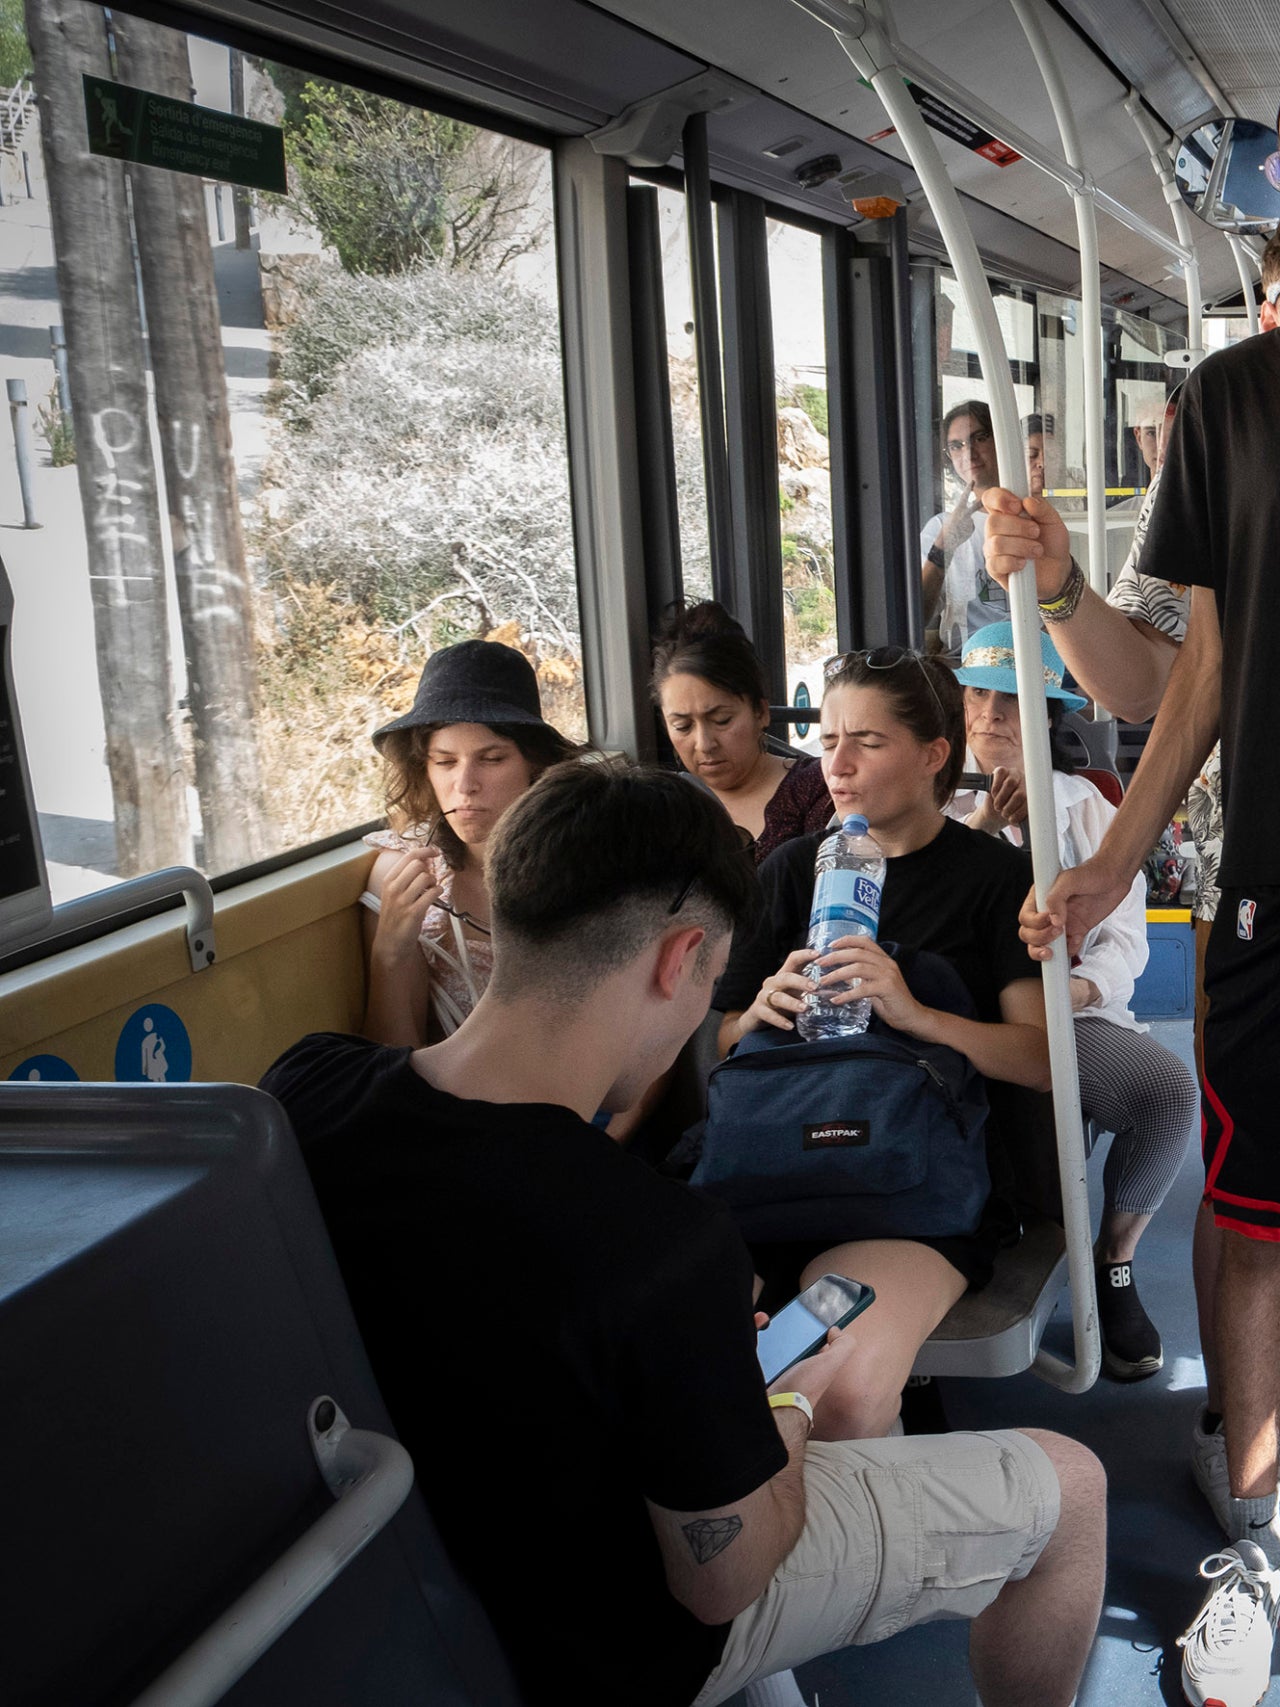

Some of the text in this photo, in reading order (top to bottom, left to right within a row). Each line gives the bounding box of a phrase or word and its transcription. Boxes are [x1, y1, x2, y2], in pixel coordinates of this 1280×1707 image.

[149, 101, 190, 124] Sortida
[150, 120, 184, 142] Salida
[186, 128, 200, 146] de
[152, 143, 210, 170] Emergency
[811, 1129, 859, 1139] EASTPAK
